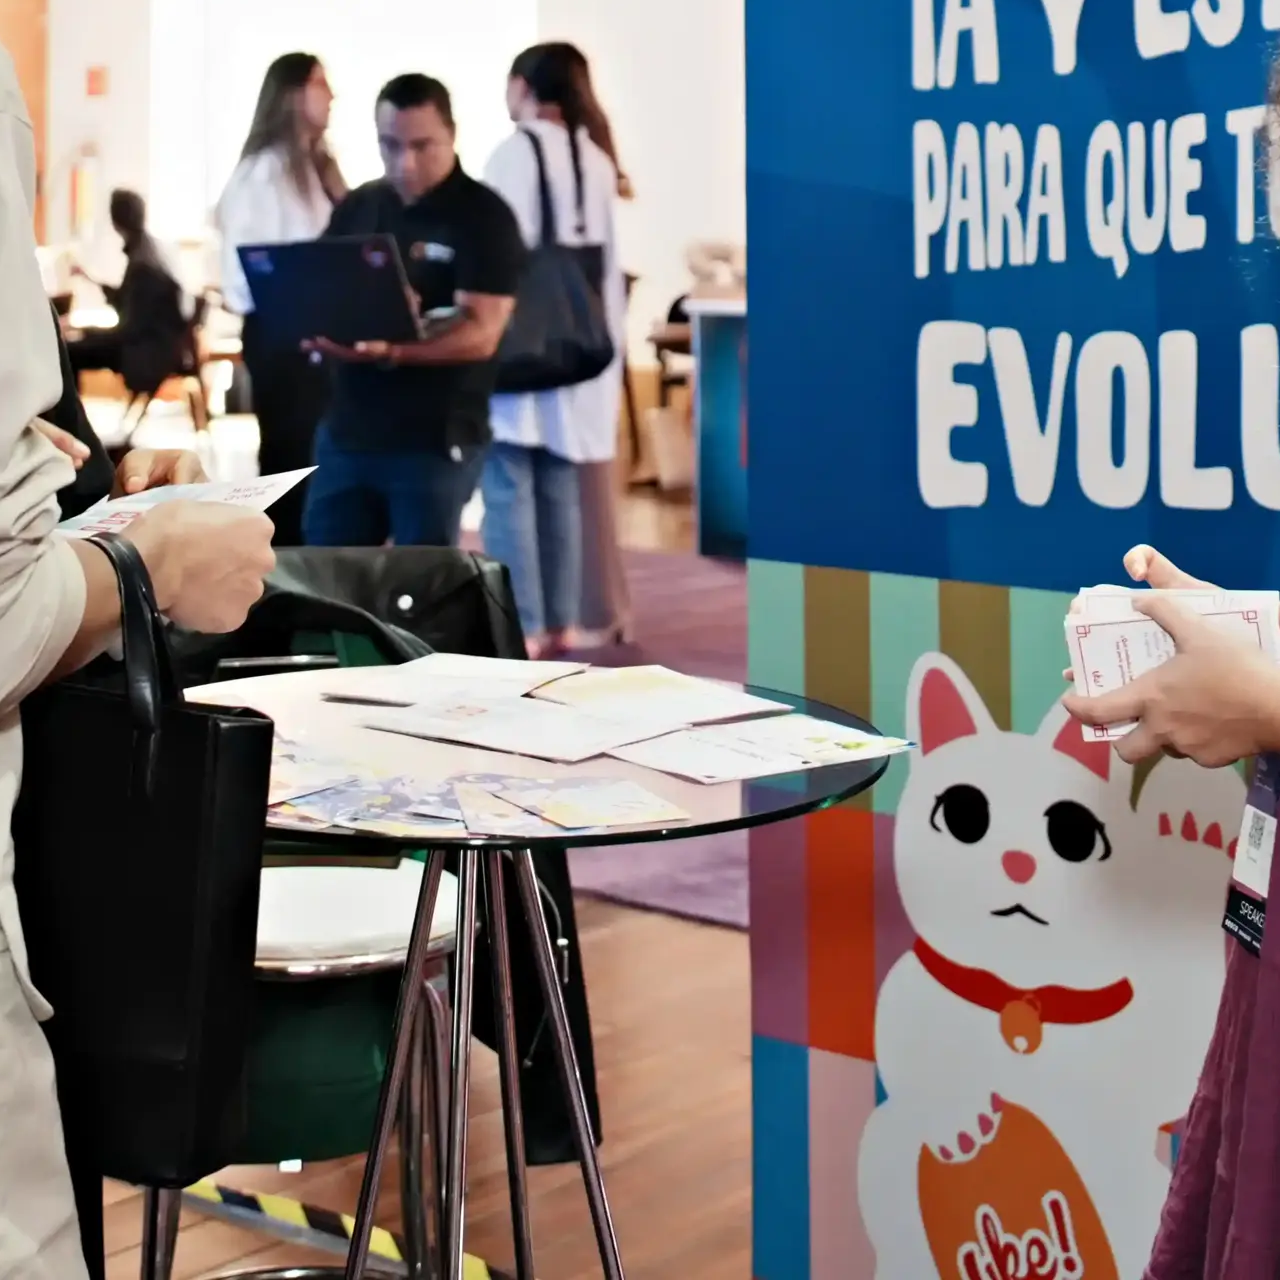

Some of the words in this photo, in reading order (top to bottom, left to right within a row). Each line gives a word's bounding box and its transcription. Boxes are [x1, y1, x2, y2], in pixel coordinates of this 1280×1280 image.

[912, 119, 1067, 279] PARA
[1086, 113, 1207, 280] QUE
[1239, 900, 1266, 929] SPEAKE
